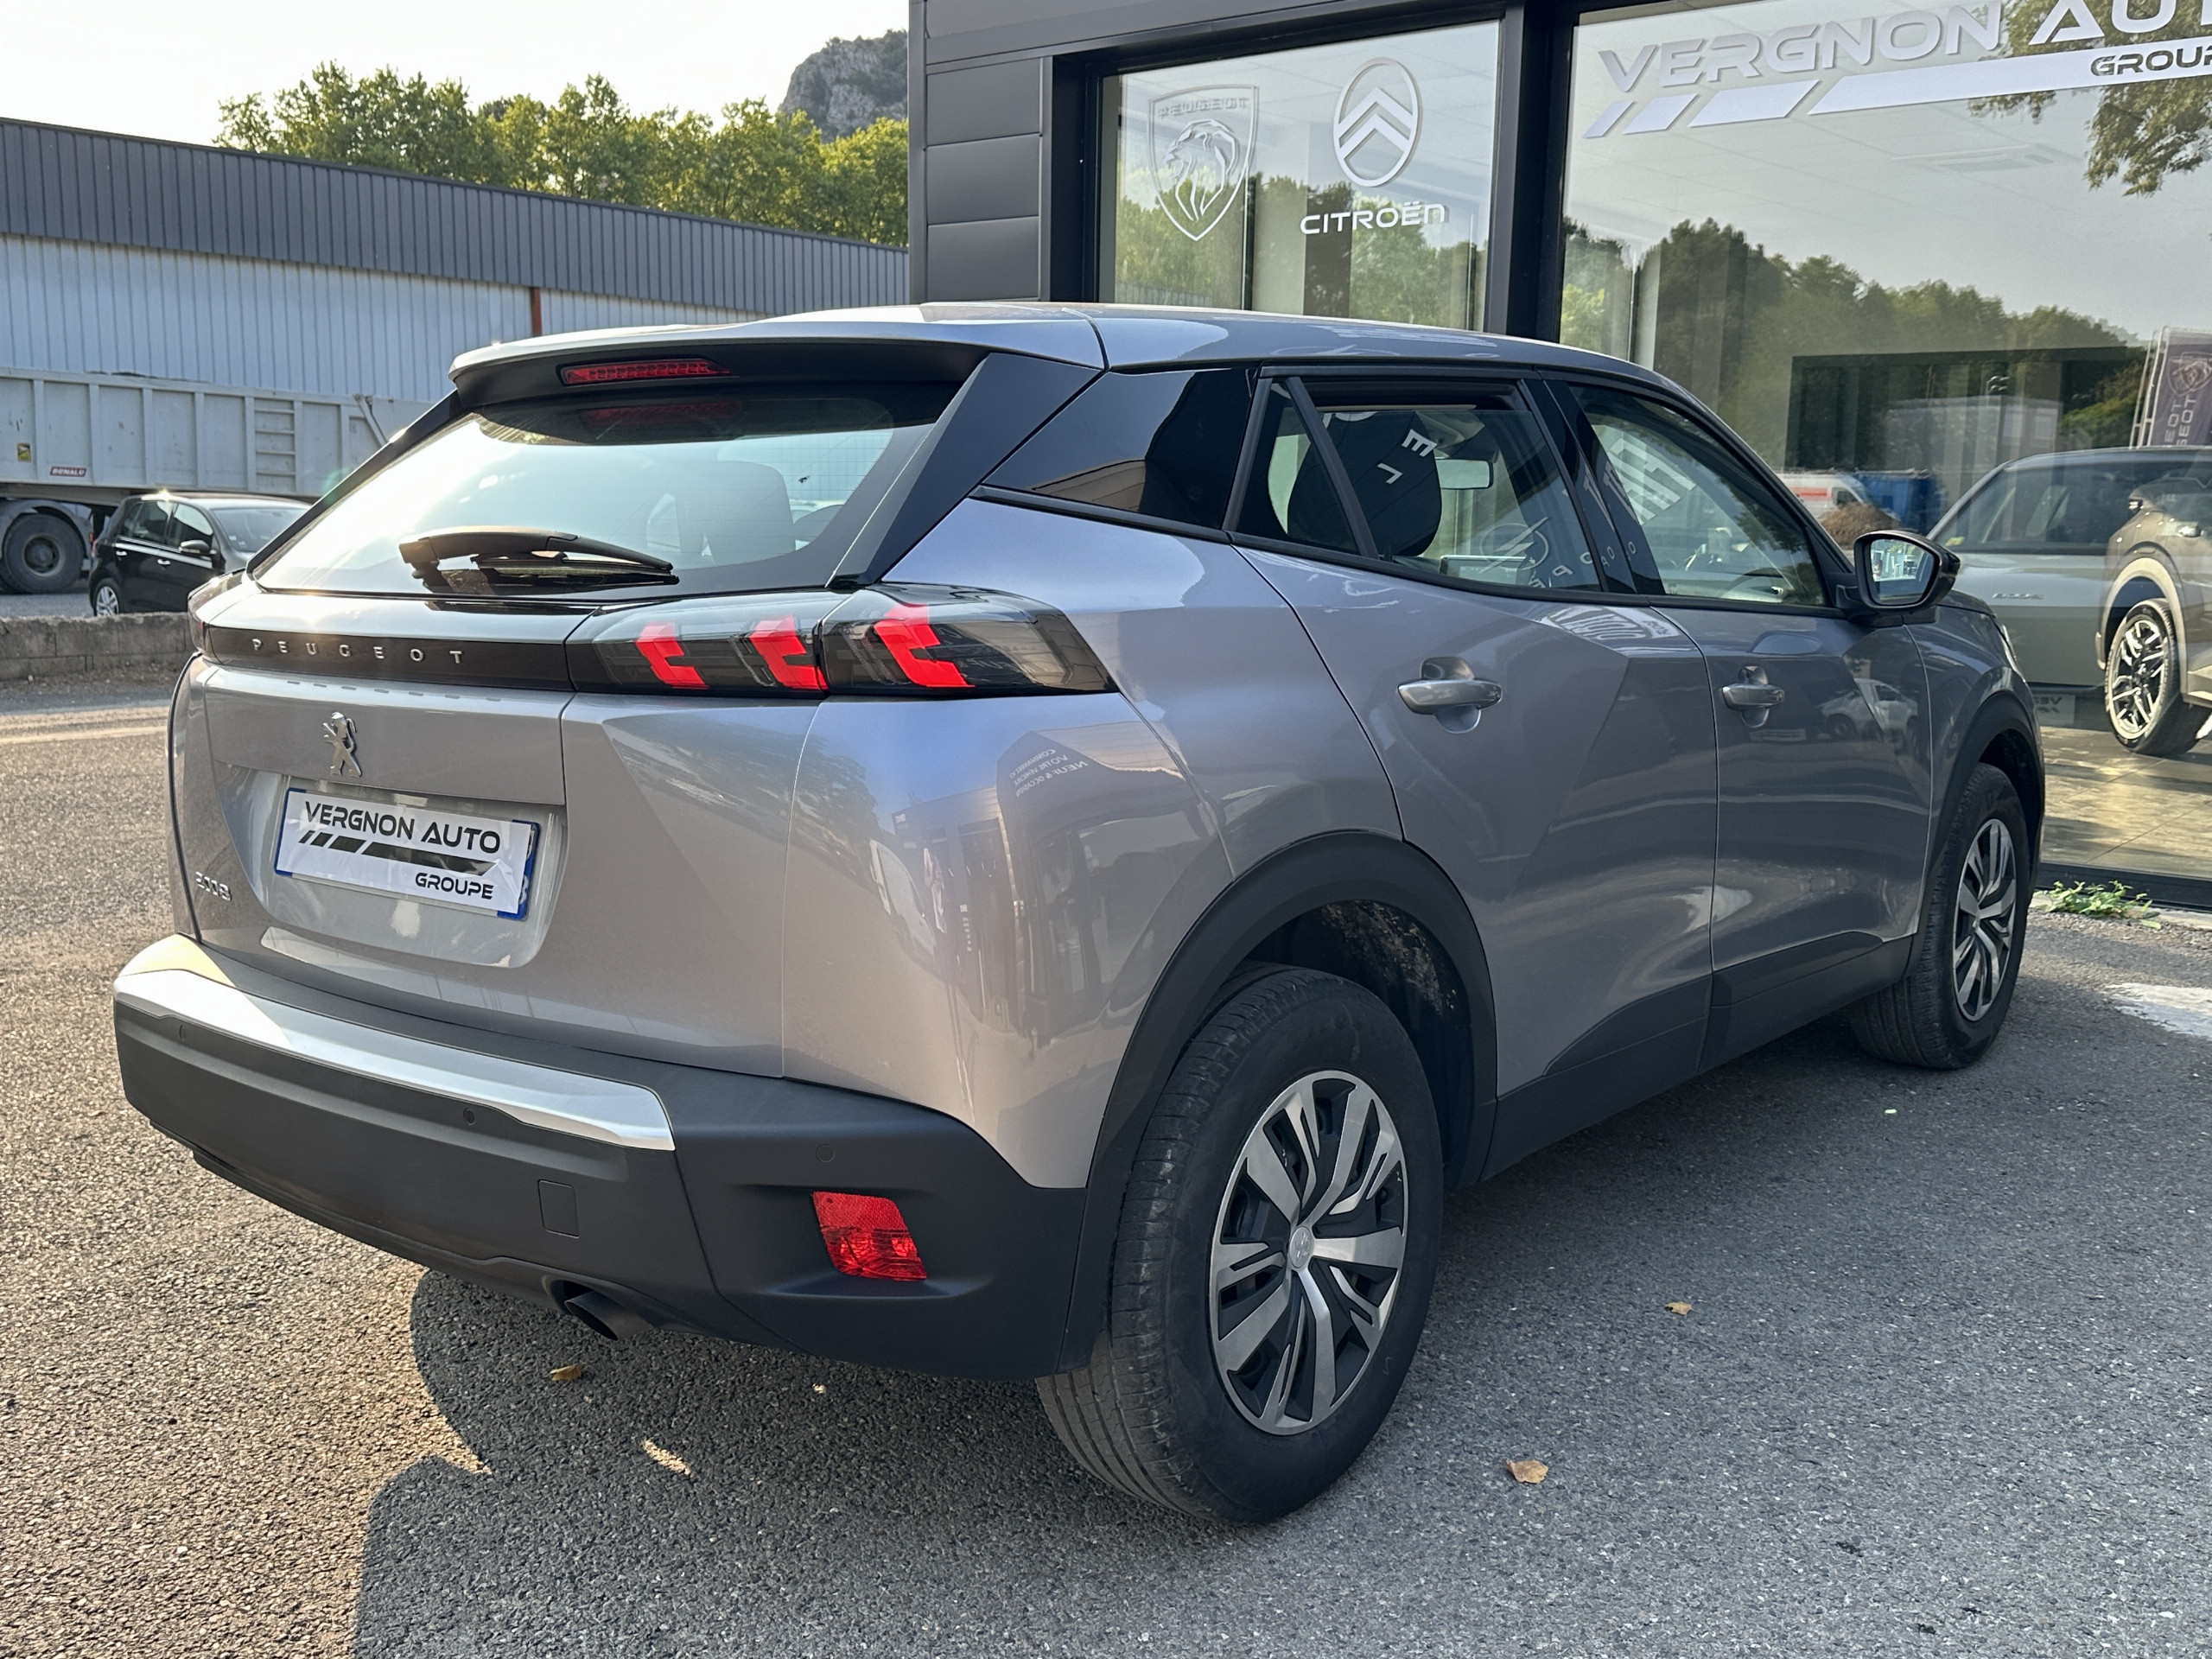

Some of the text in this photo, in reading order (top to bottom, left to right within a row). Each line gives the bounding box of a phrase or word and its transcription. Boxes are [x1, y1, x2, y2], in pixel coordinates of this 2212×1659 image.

[1598, 0, 2212, 92] VERGNON AU
[2089, 46, 2212, 77] GROU
[1159, 97, 1250, 118] PEUGEOT
[252, 639, 463, 664] PEUGEOT
[305, 801, 501, 854] VERGNON AUTO
[195, 871, 232, 901] 2008
[416, 872, 494, 899] GROUPE
